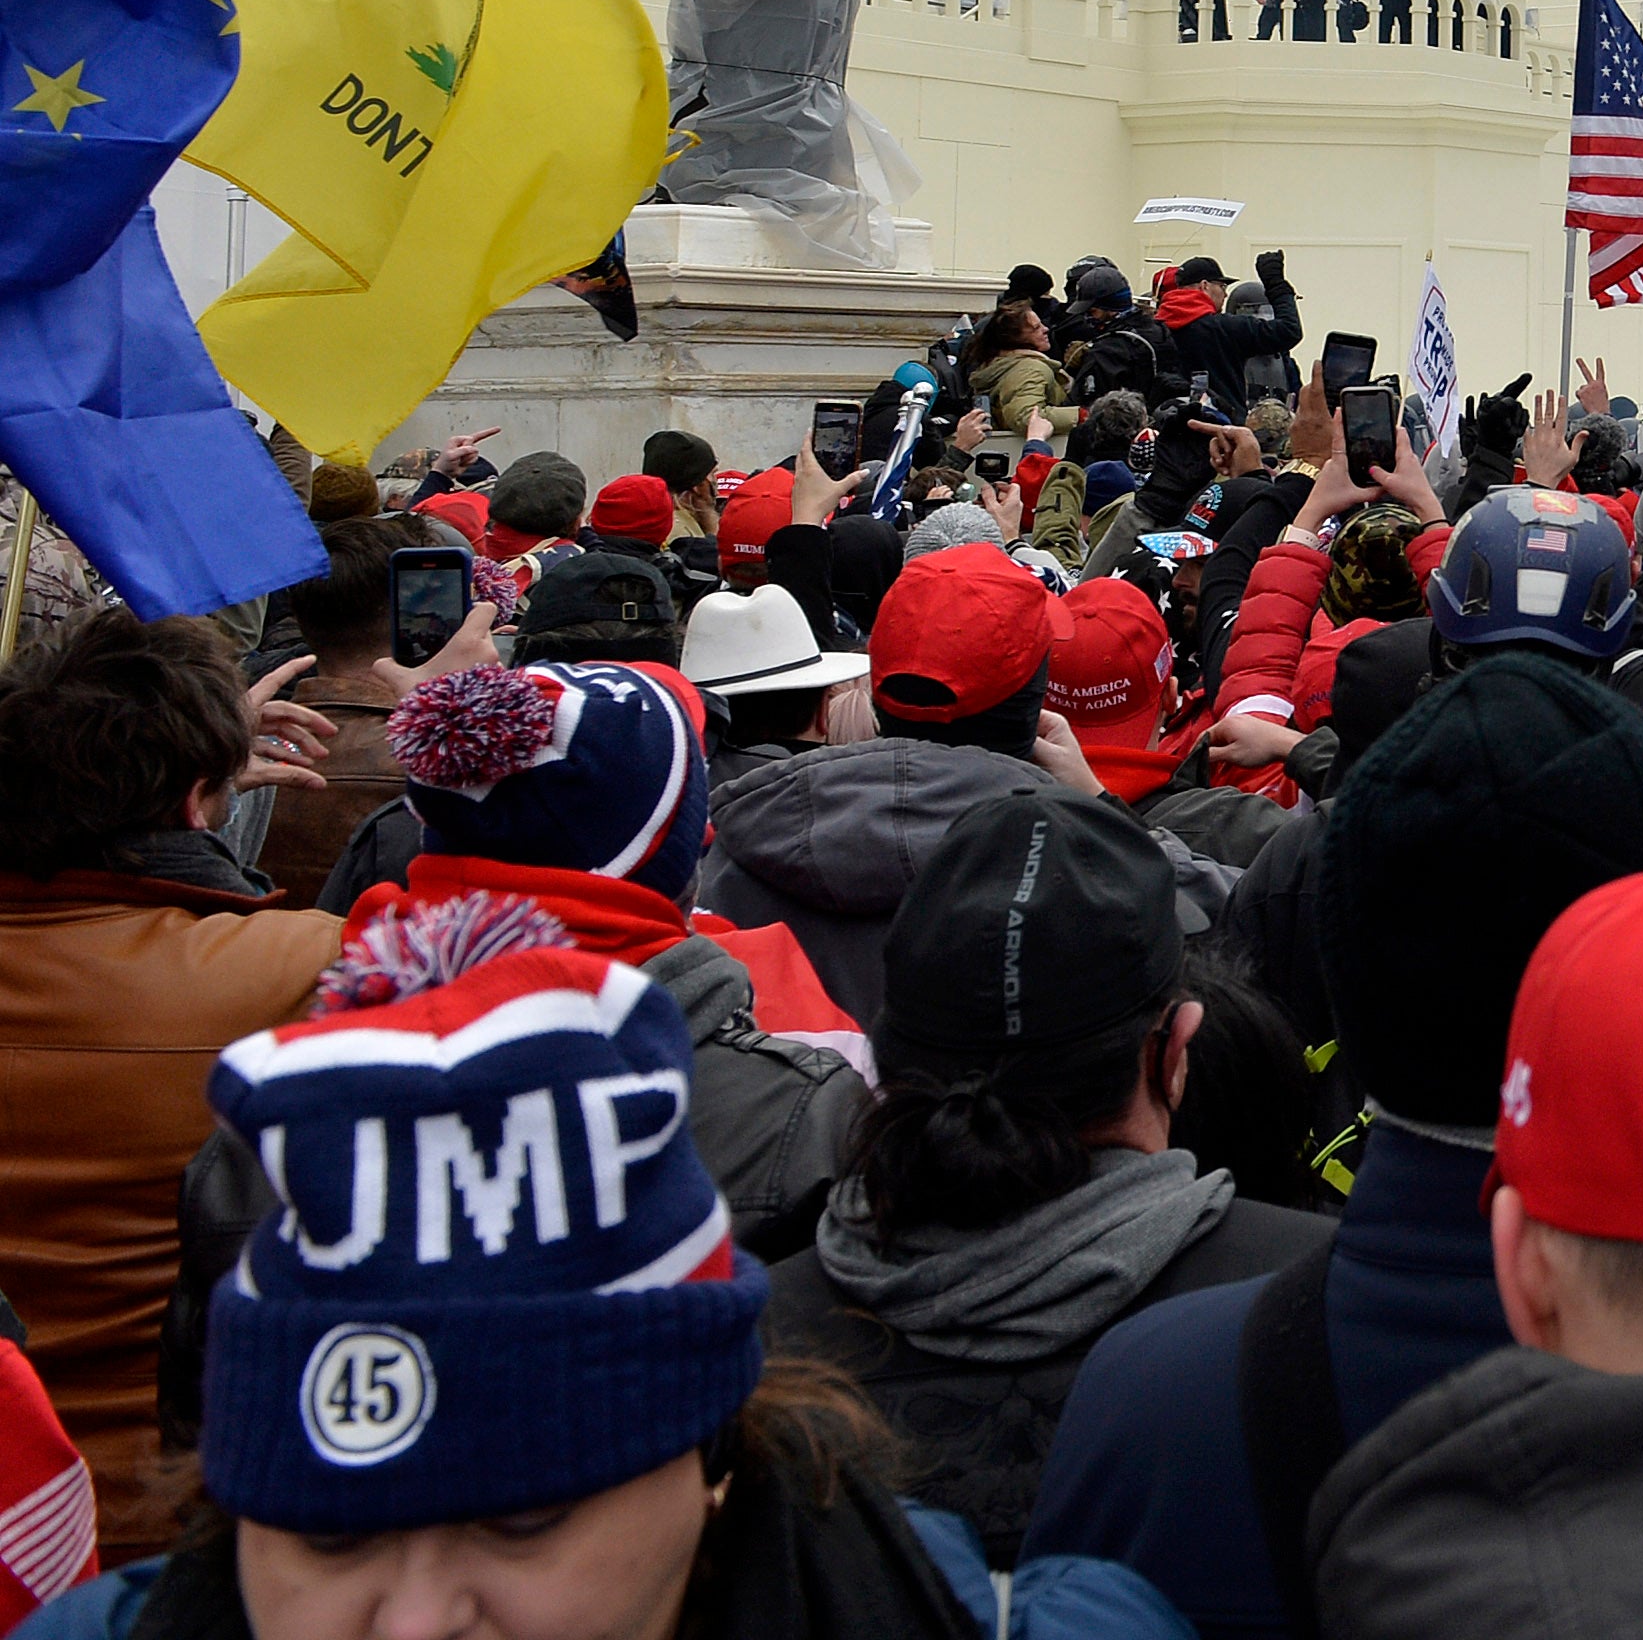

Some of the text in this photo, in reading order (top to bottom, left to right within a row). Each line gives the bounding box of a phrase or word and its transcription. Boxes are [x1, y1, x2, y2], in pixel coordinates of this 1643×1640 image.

[733, 543, 765, 555] TRUM
[1047, 677, 1132, 698] AKE AMERICA
[1085, 692, 1128, 711] AGAIN
[1013, 820, 1048, 903] UNDER
[1003, 910, 1025, 1037] ARMOUR
[326, 1351, 402, 1424] 45
